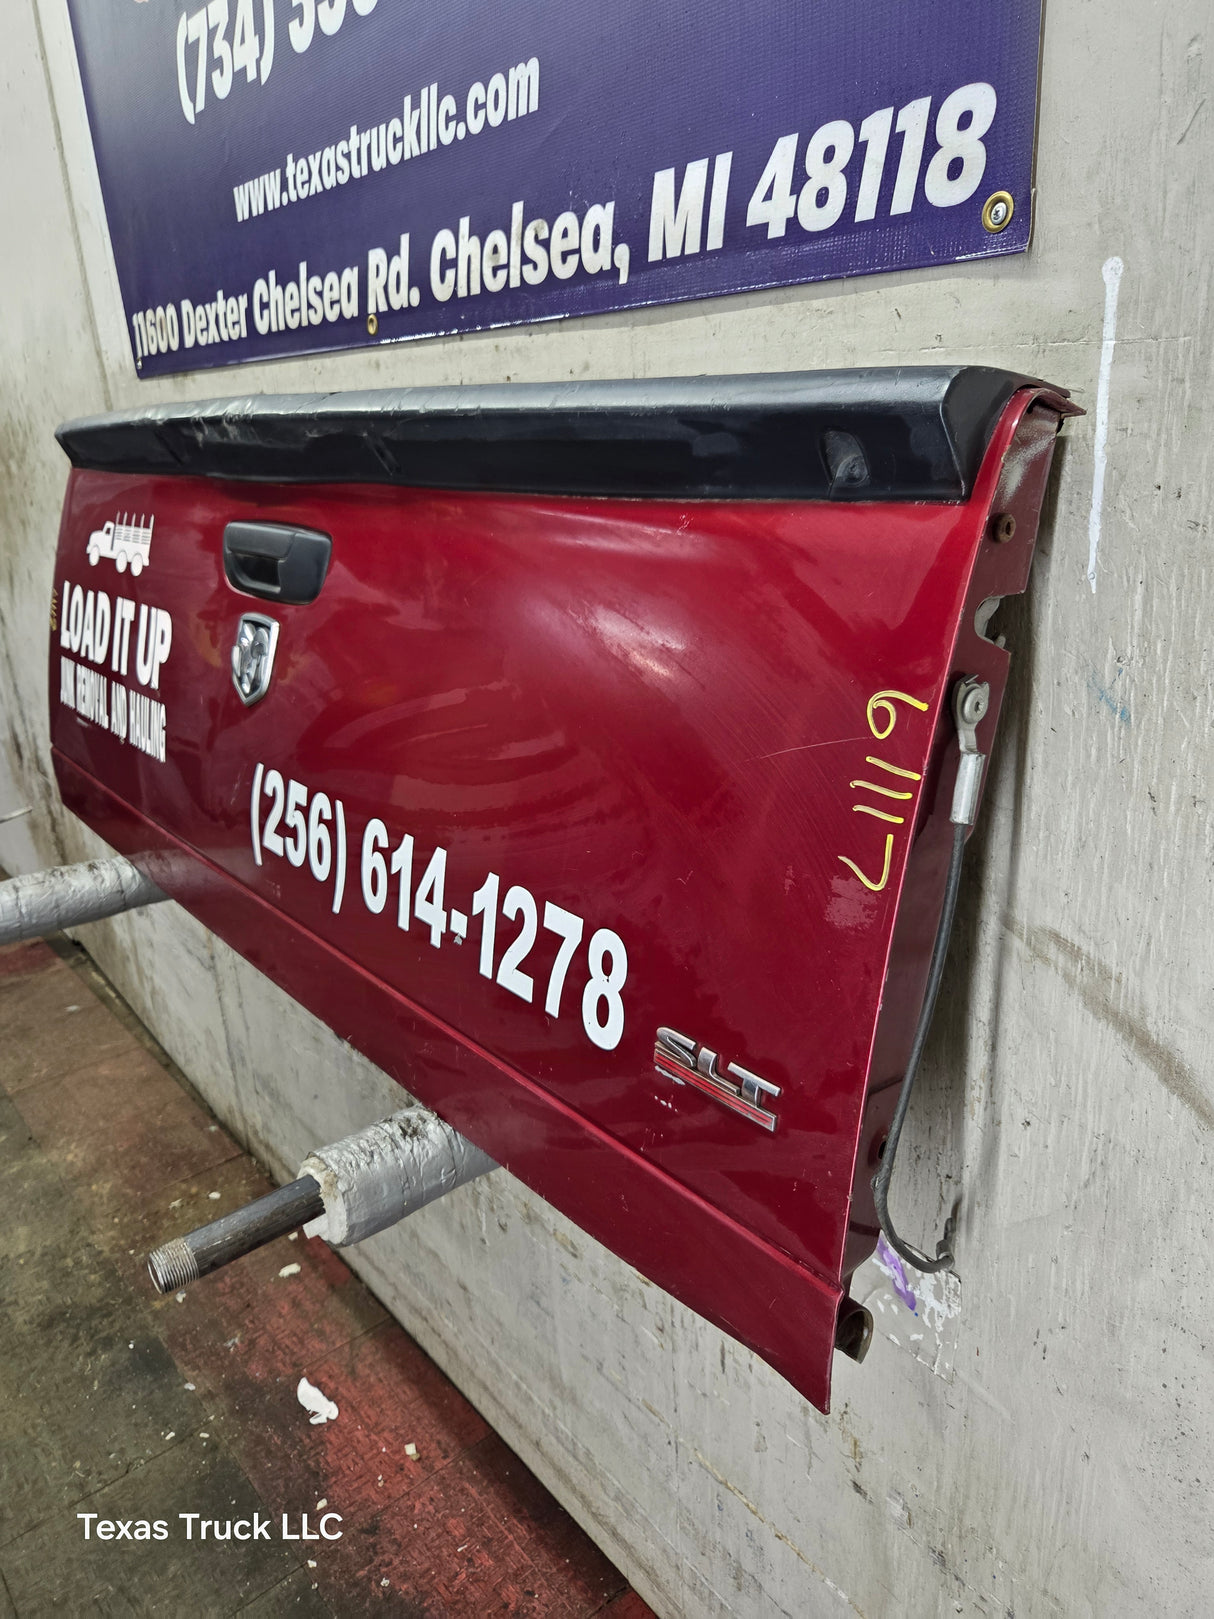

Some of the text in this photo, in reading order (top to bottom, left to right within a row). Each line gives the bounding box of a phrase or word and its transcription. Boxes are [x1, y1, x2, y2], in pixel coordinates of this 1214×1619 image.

[176, 0, 275, 124] (734)
[233, 57, 540, 222] www.texastruckllc.com
[132, 83, 997, 357] 11600 Dexter Chelsea Rd. Chelsea, MI 48118
[60, 580, 111, 665] LOAD
[111, 596, 136, 677] IT
[136, 604, 173, 690] UP
[129, 689, 167, 763] HAULING
[251, 762, 628, 1050] (256) 614-1278
[655, 1027, 782, 1108] SLT
